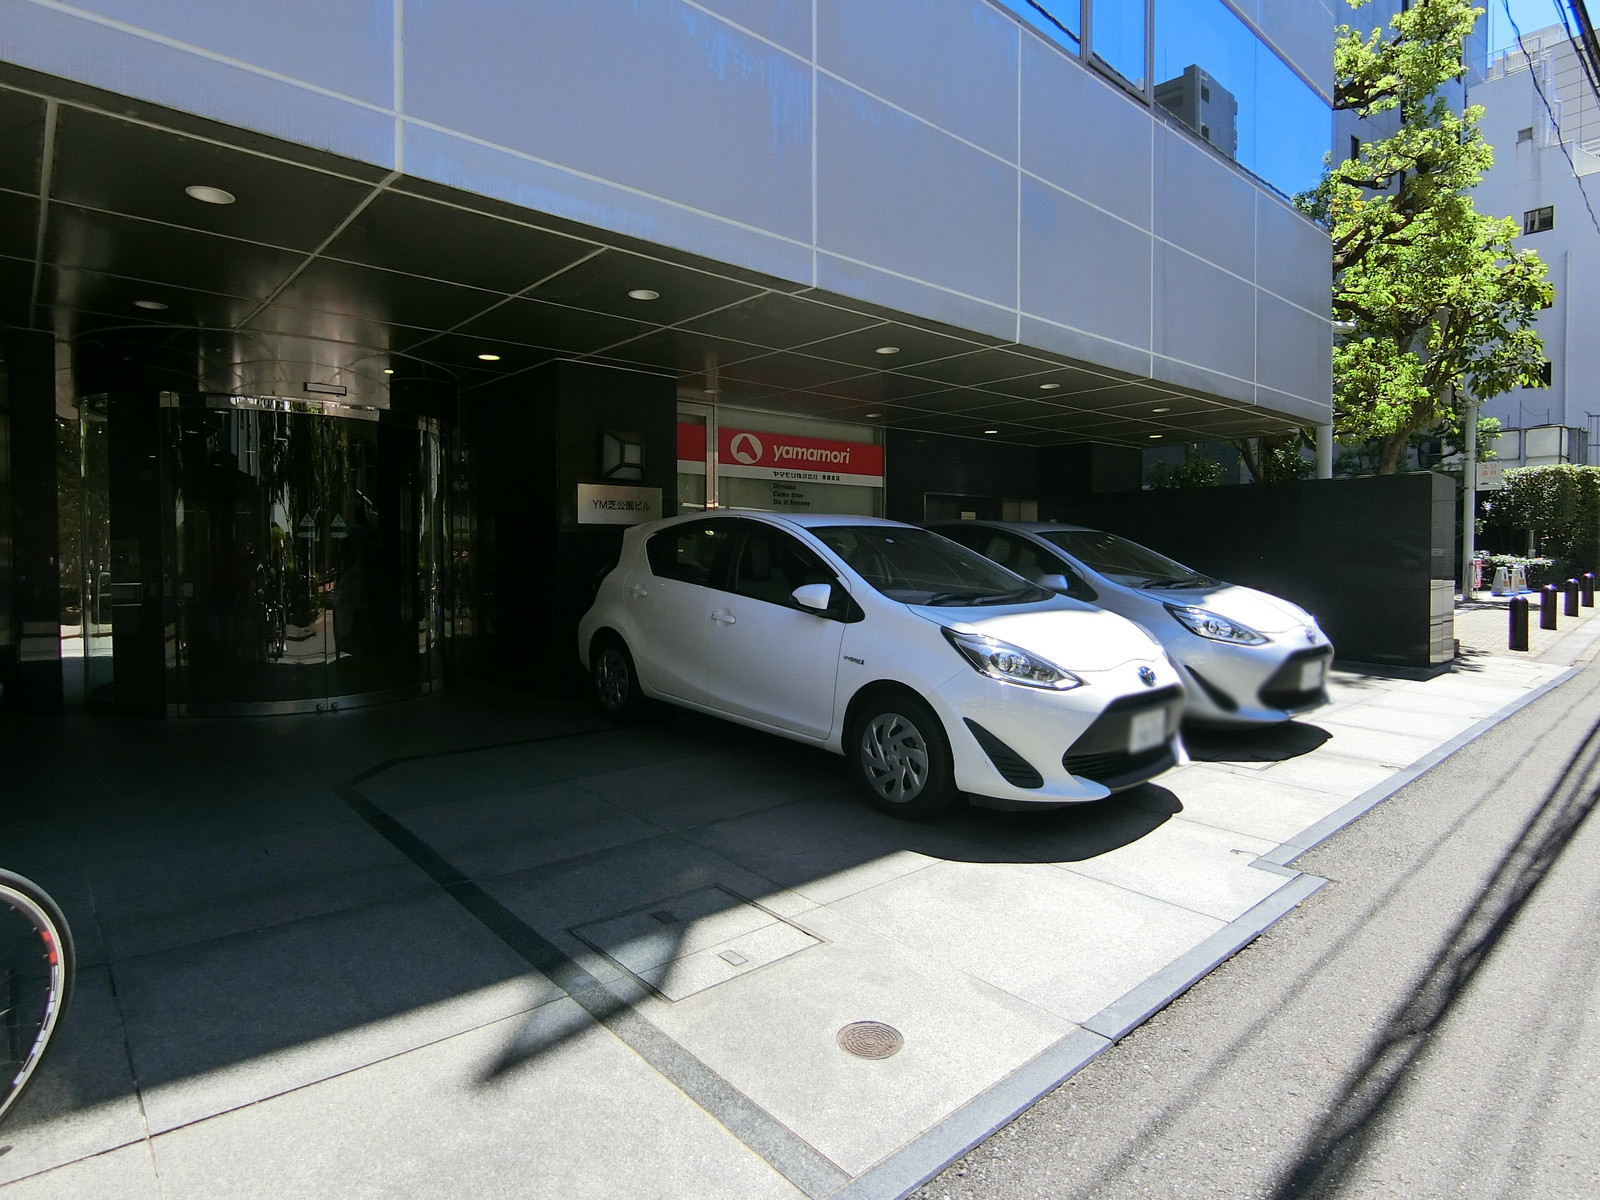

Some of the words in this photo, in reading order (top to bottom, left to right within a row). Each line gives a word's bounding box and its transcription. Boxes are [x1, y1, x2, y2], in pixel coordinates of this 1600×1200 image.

[773, 444, 850, 464] yamamori
[773, 471, 818, 480] ヤマモリ株式会社
[592, 499, 651, 511] YM芝公園ビル
